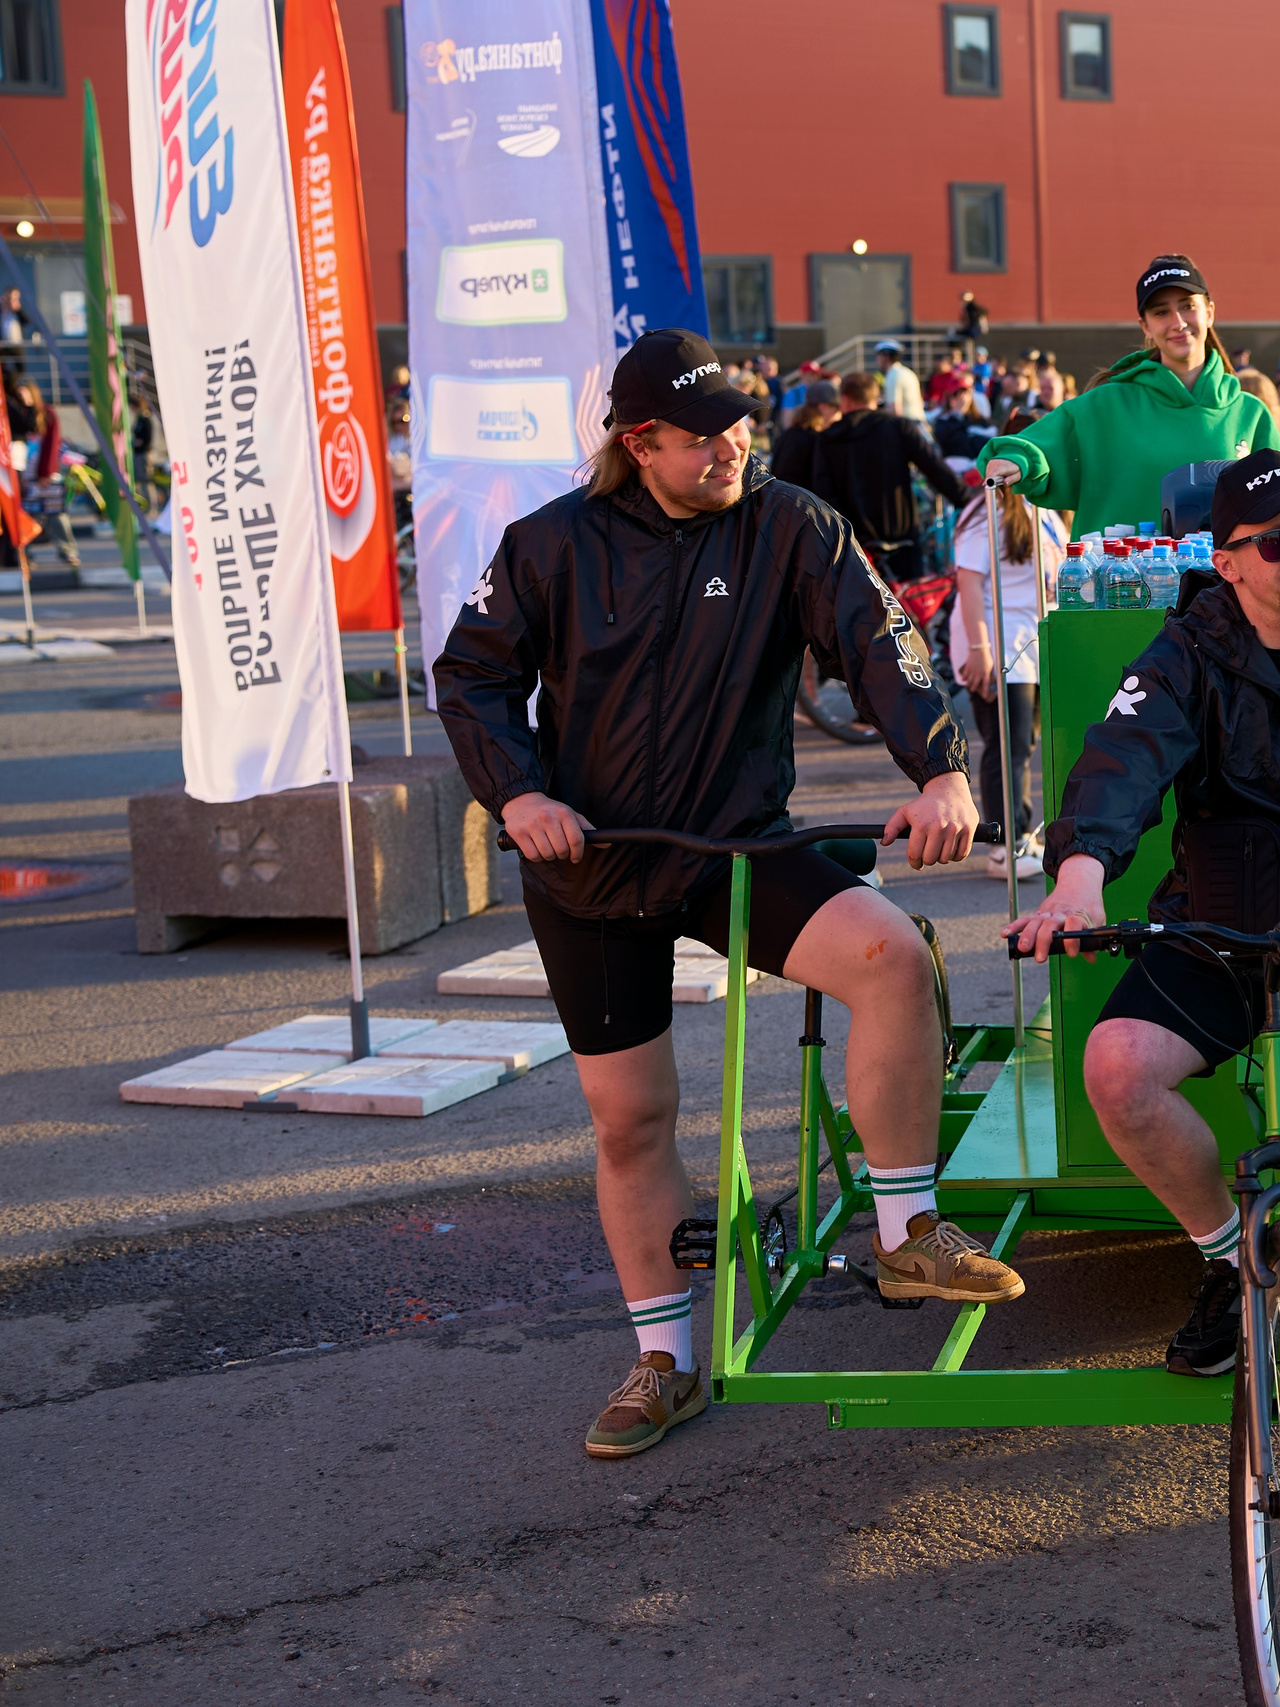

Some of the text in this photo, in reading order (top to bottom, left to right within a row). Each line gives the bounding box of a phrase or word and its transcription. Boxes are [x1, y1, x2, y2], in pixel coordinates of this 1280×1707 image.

[601, 103, 640, 289] НЕФТИ
[1143, 267, 1190, 287] купер
[671, 361, 722, 391] купер
